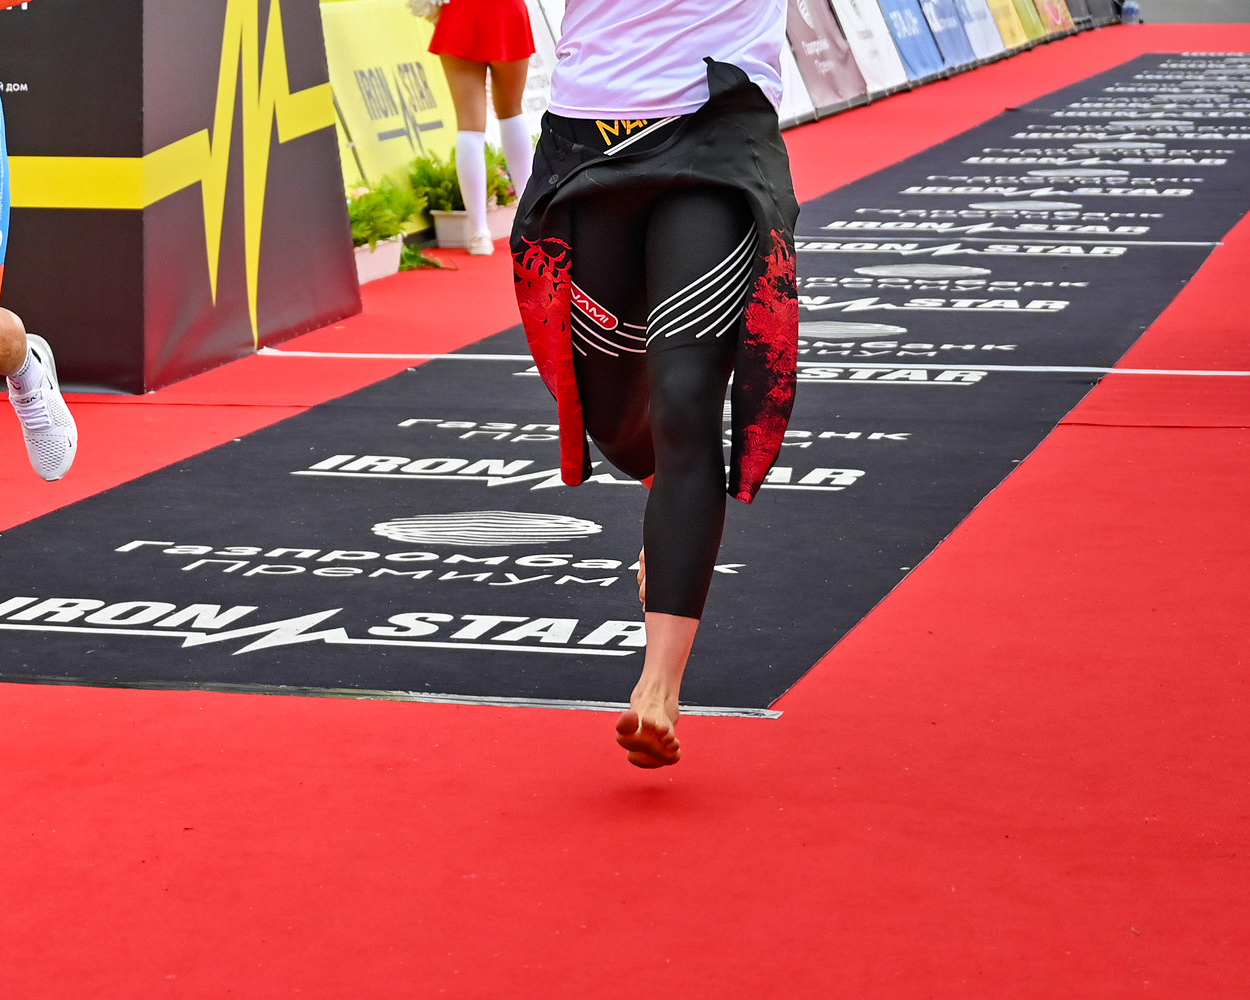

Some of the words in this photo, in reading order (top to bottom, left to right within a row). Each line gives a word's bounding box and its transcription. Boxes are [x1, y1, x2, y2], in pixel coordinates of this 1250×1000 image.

[904, 299, 1071, 310] STAR
[800, 367, 988, 383] STAR
[308, 454, 535, 475] IRON
[114, 540, 747, 574] Газпромбак
[181, 558, 619, 587] Премиум
[367, 611, 648, 647] STAR
